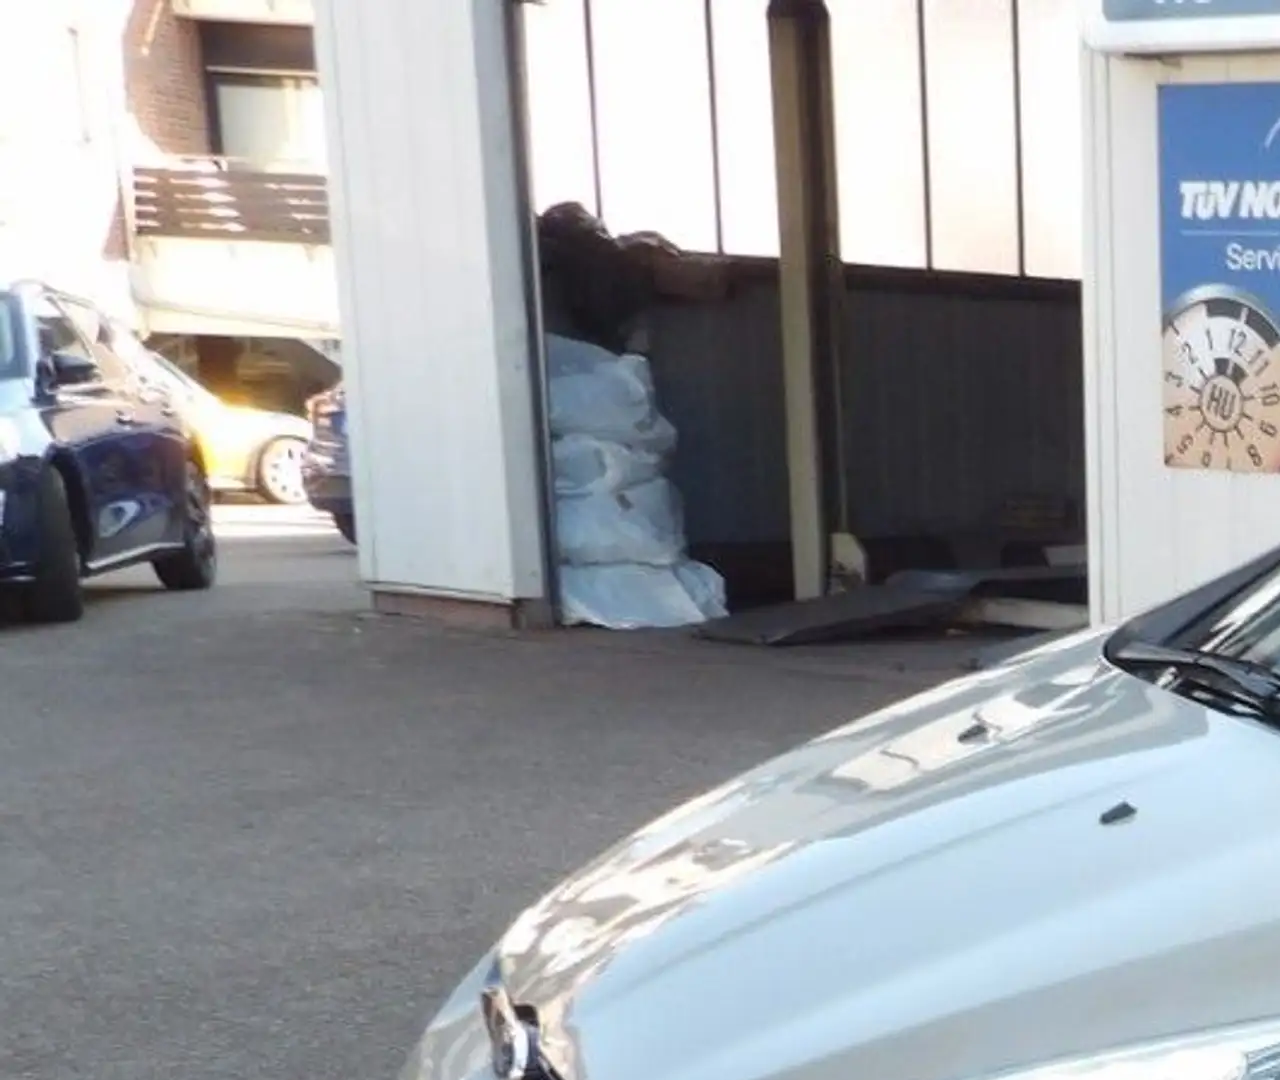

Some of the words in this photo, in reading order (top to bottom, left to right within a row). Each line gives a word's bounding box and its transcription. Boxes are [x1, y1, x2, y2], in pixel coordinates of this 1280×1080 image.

[1205, 328, 1214, 351] 1
[1229, 328, 1247, 357] 12
[1181, 341, 1199, 365] 2
[1247, 348, 1270, 377] 11
[1164, 371, 1184, 388] 3
[1206, 383, 1237, 421] HU
[1259, 382, 1280, 407] 10
[1176, 433, 1194, 455] 5
[1246, 443, 1263, 468] 8
